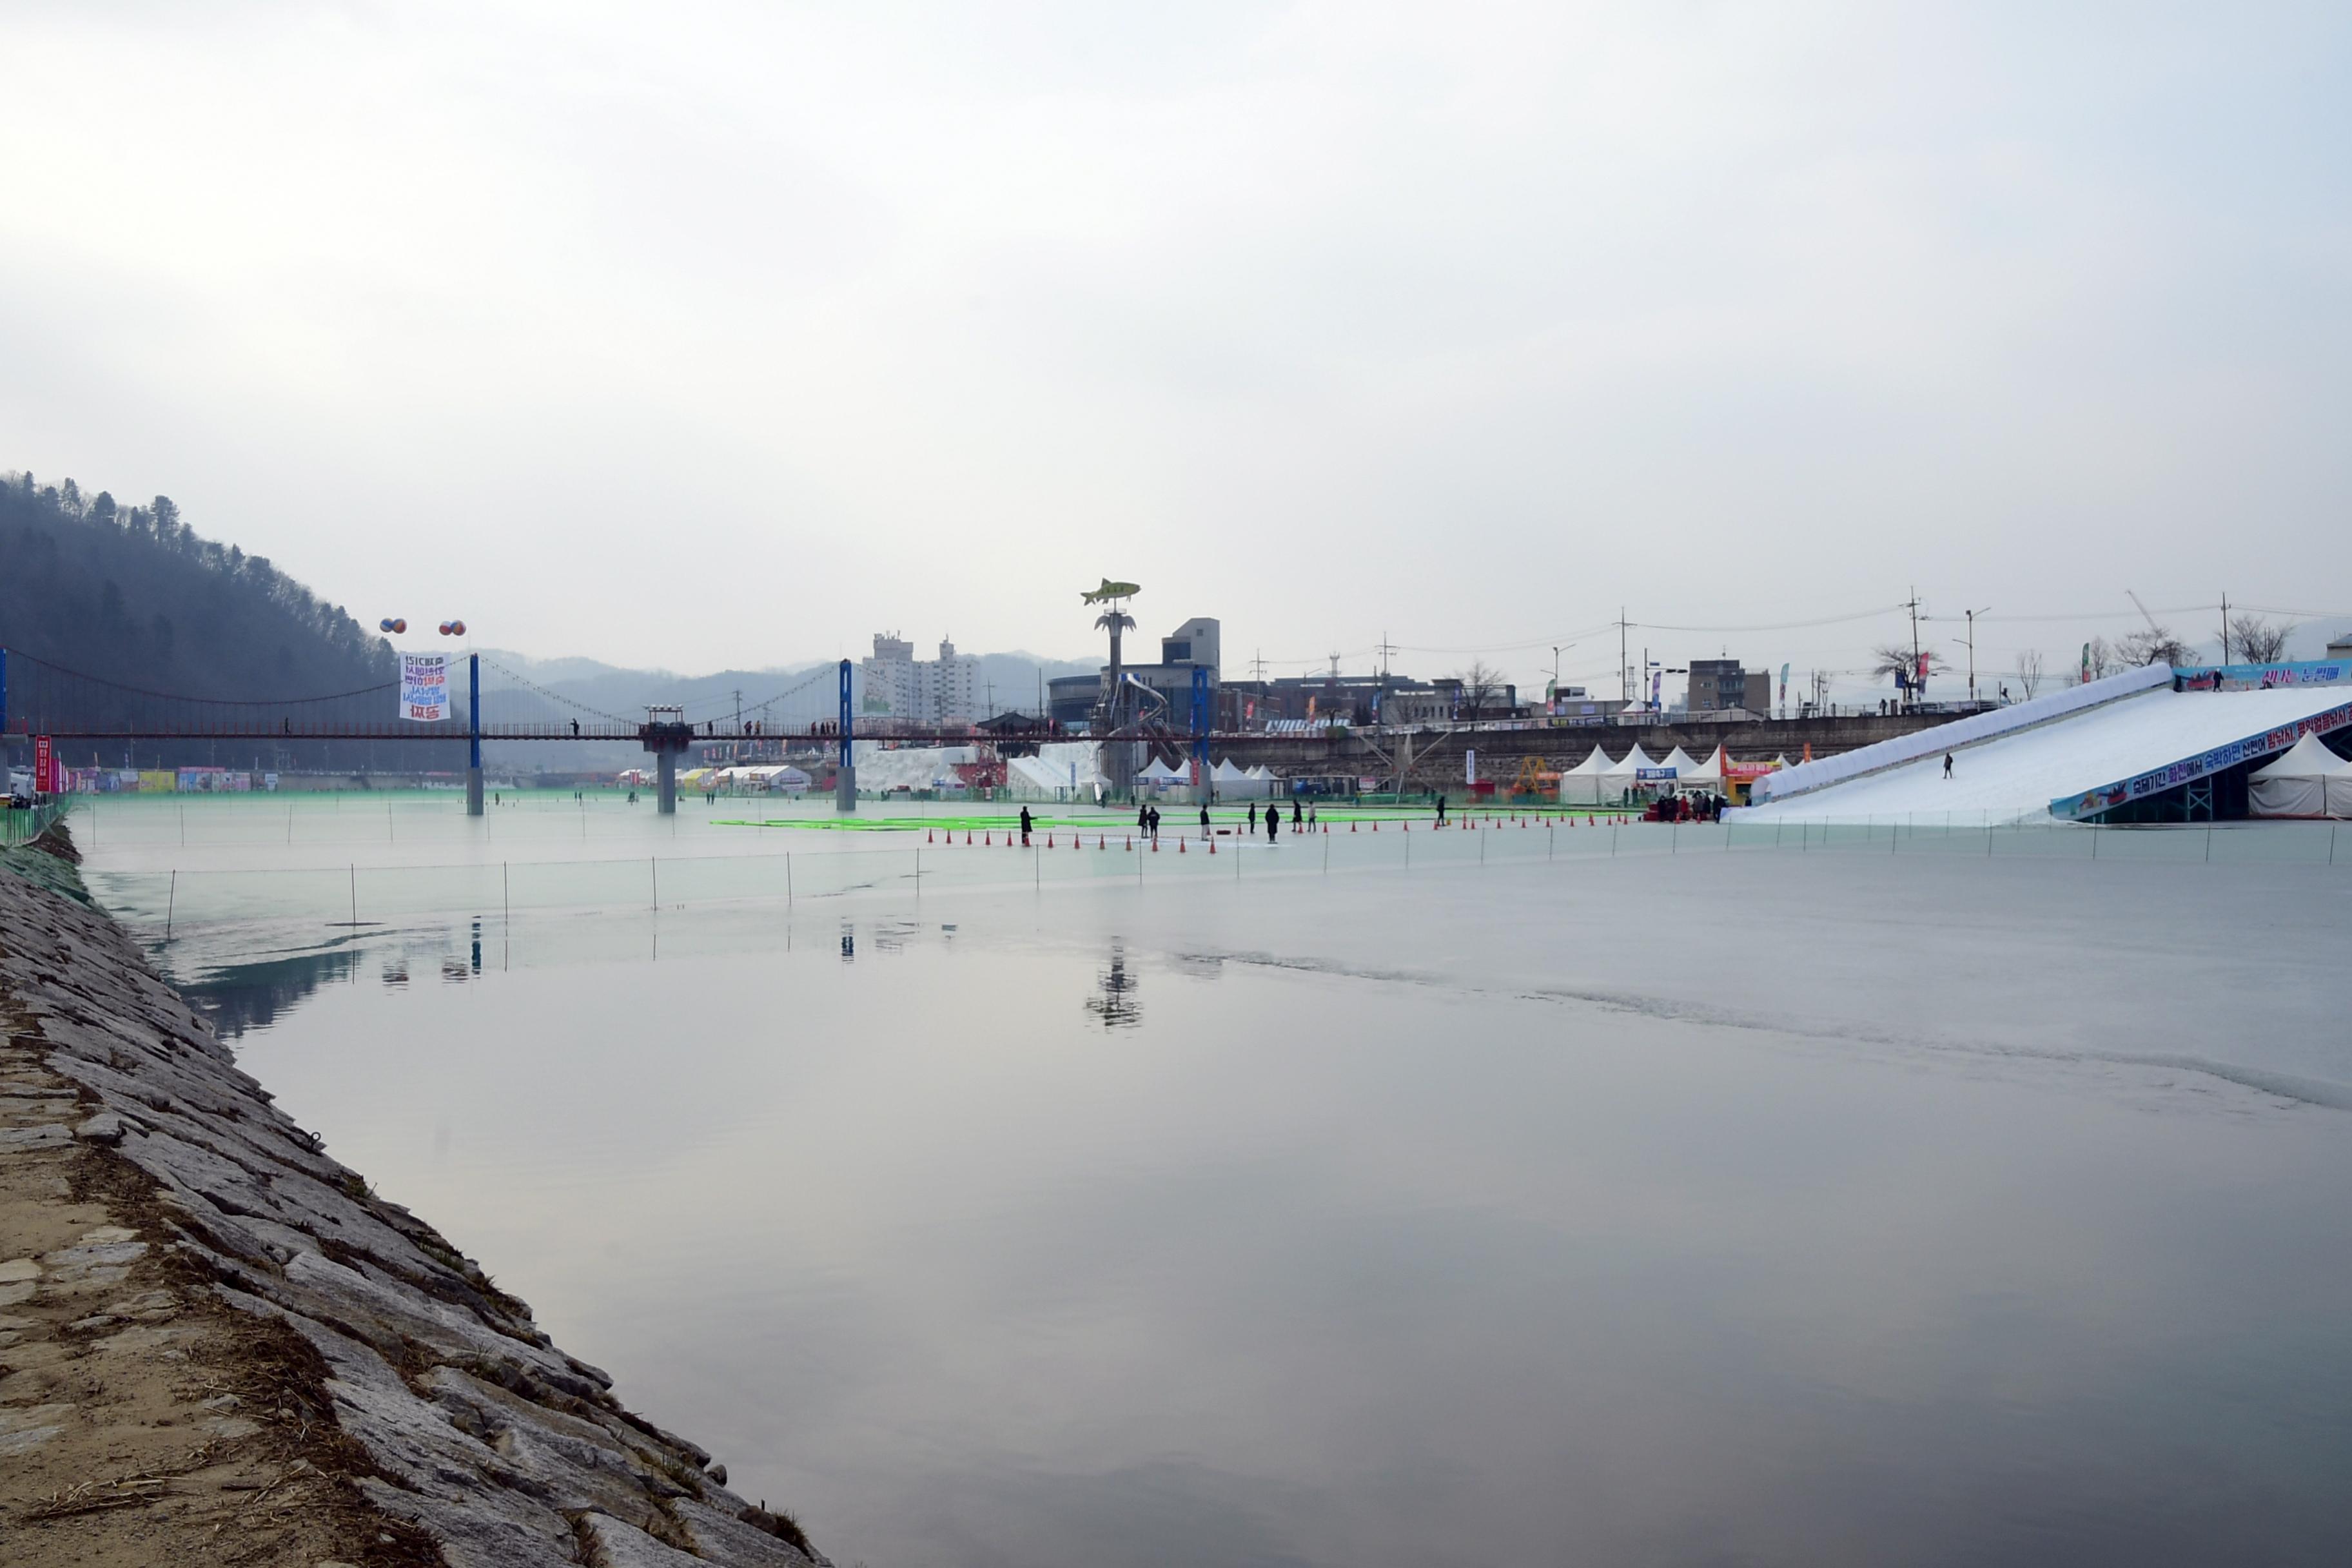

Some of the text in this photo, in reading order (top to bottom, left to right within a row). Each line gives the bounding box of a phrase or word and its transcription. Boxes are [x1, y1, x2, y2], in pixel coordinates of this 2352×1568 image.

[2302, 666, 2340, 682] 눈썰매
[2132, 771, 2166, 794] 축제기간
[2168, 759, 2203, 783] 화천에서
[2205, 744, 2240, 769] 숙박하면
[2242, 737, 2266, 758] 산천어
